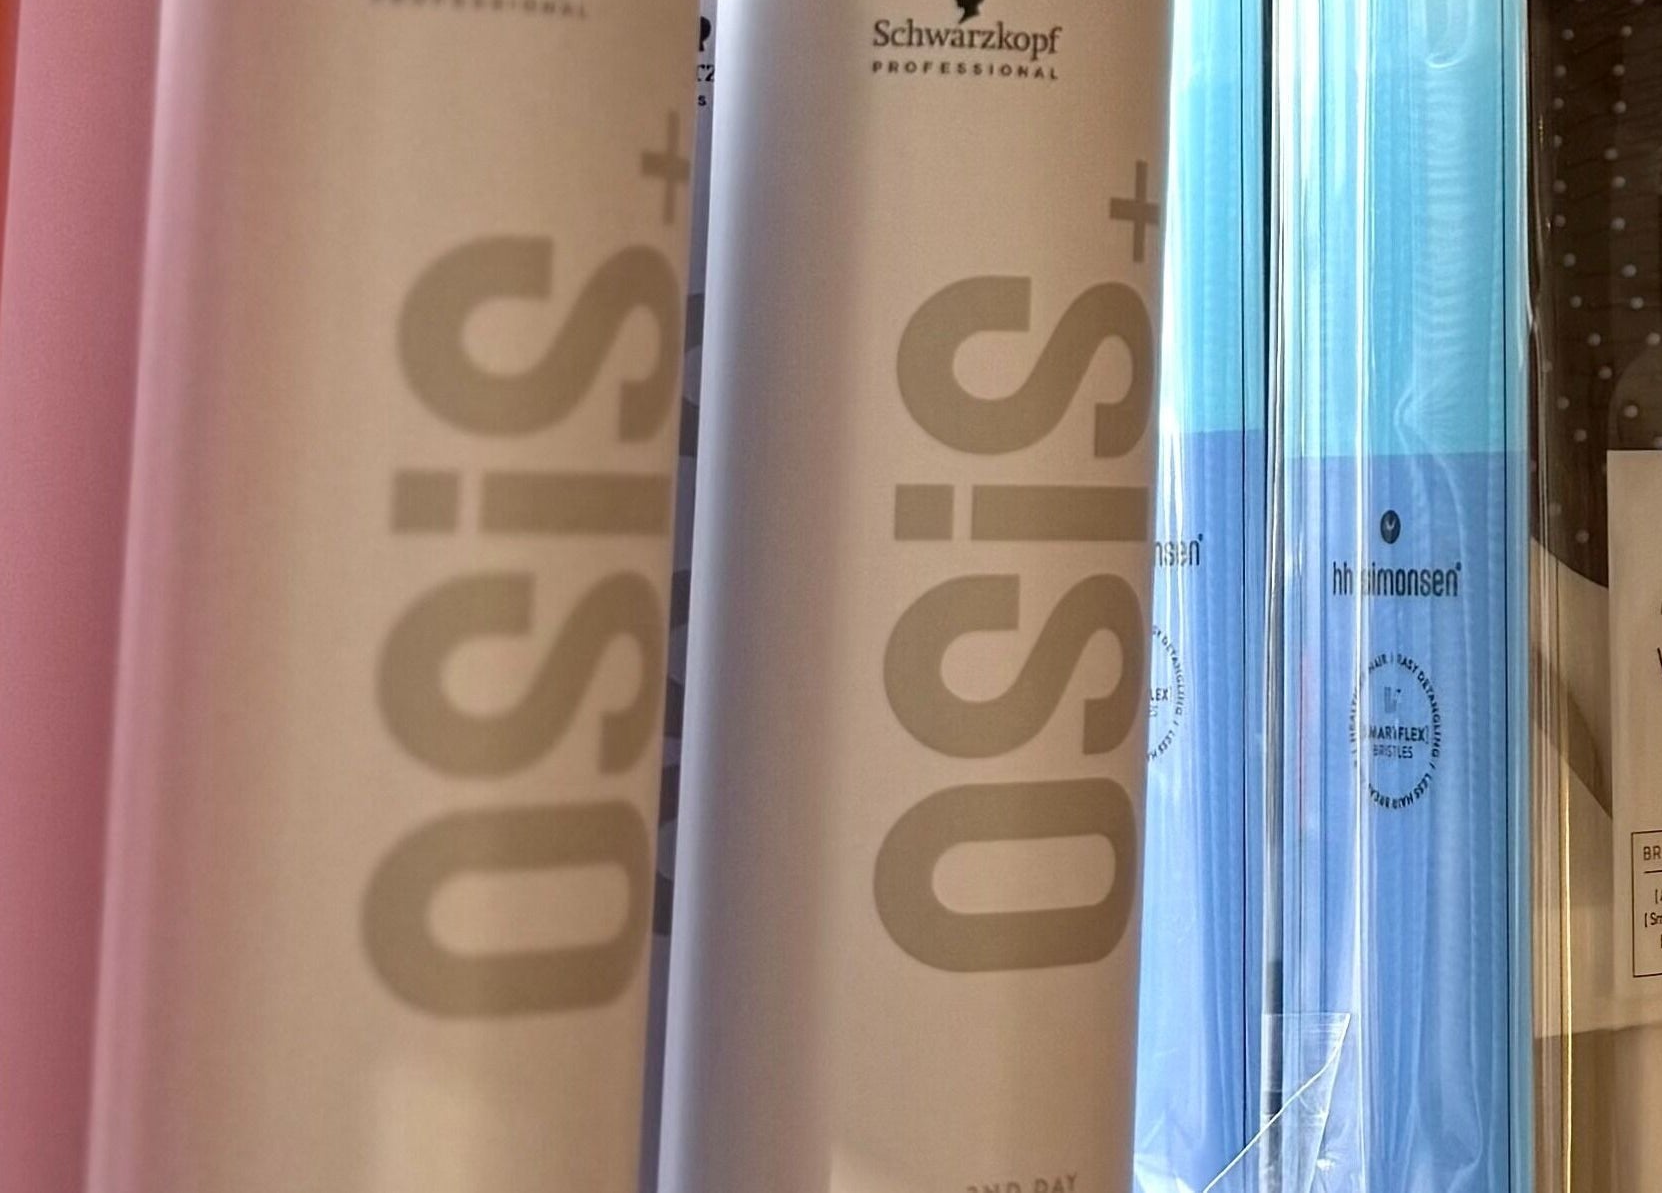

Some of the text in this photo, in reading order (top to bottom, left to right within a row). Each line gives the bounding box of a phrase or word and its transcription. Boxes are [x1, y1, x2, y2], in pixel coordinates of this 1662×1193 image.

[872, 18, 1062, 61] Schwarzkopf
[871, 60, 1059, 80] PROFESSIONAL
[1333, 562, 1353, 596] hh
[1417, 670, 1442, 758] DETANGLING
[1034, 1171, 1078, 1193] DAY
